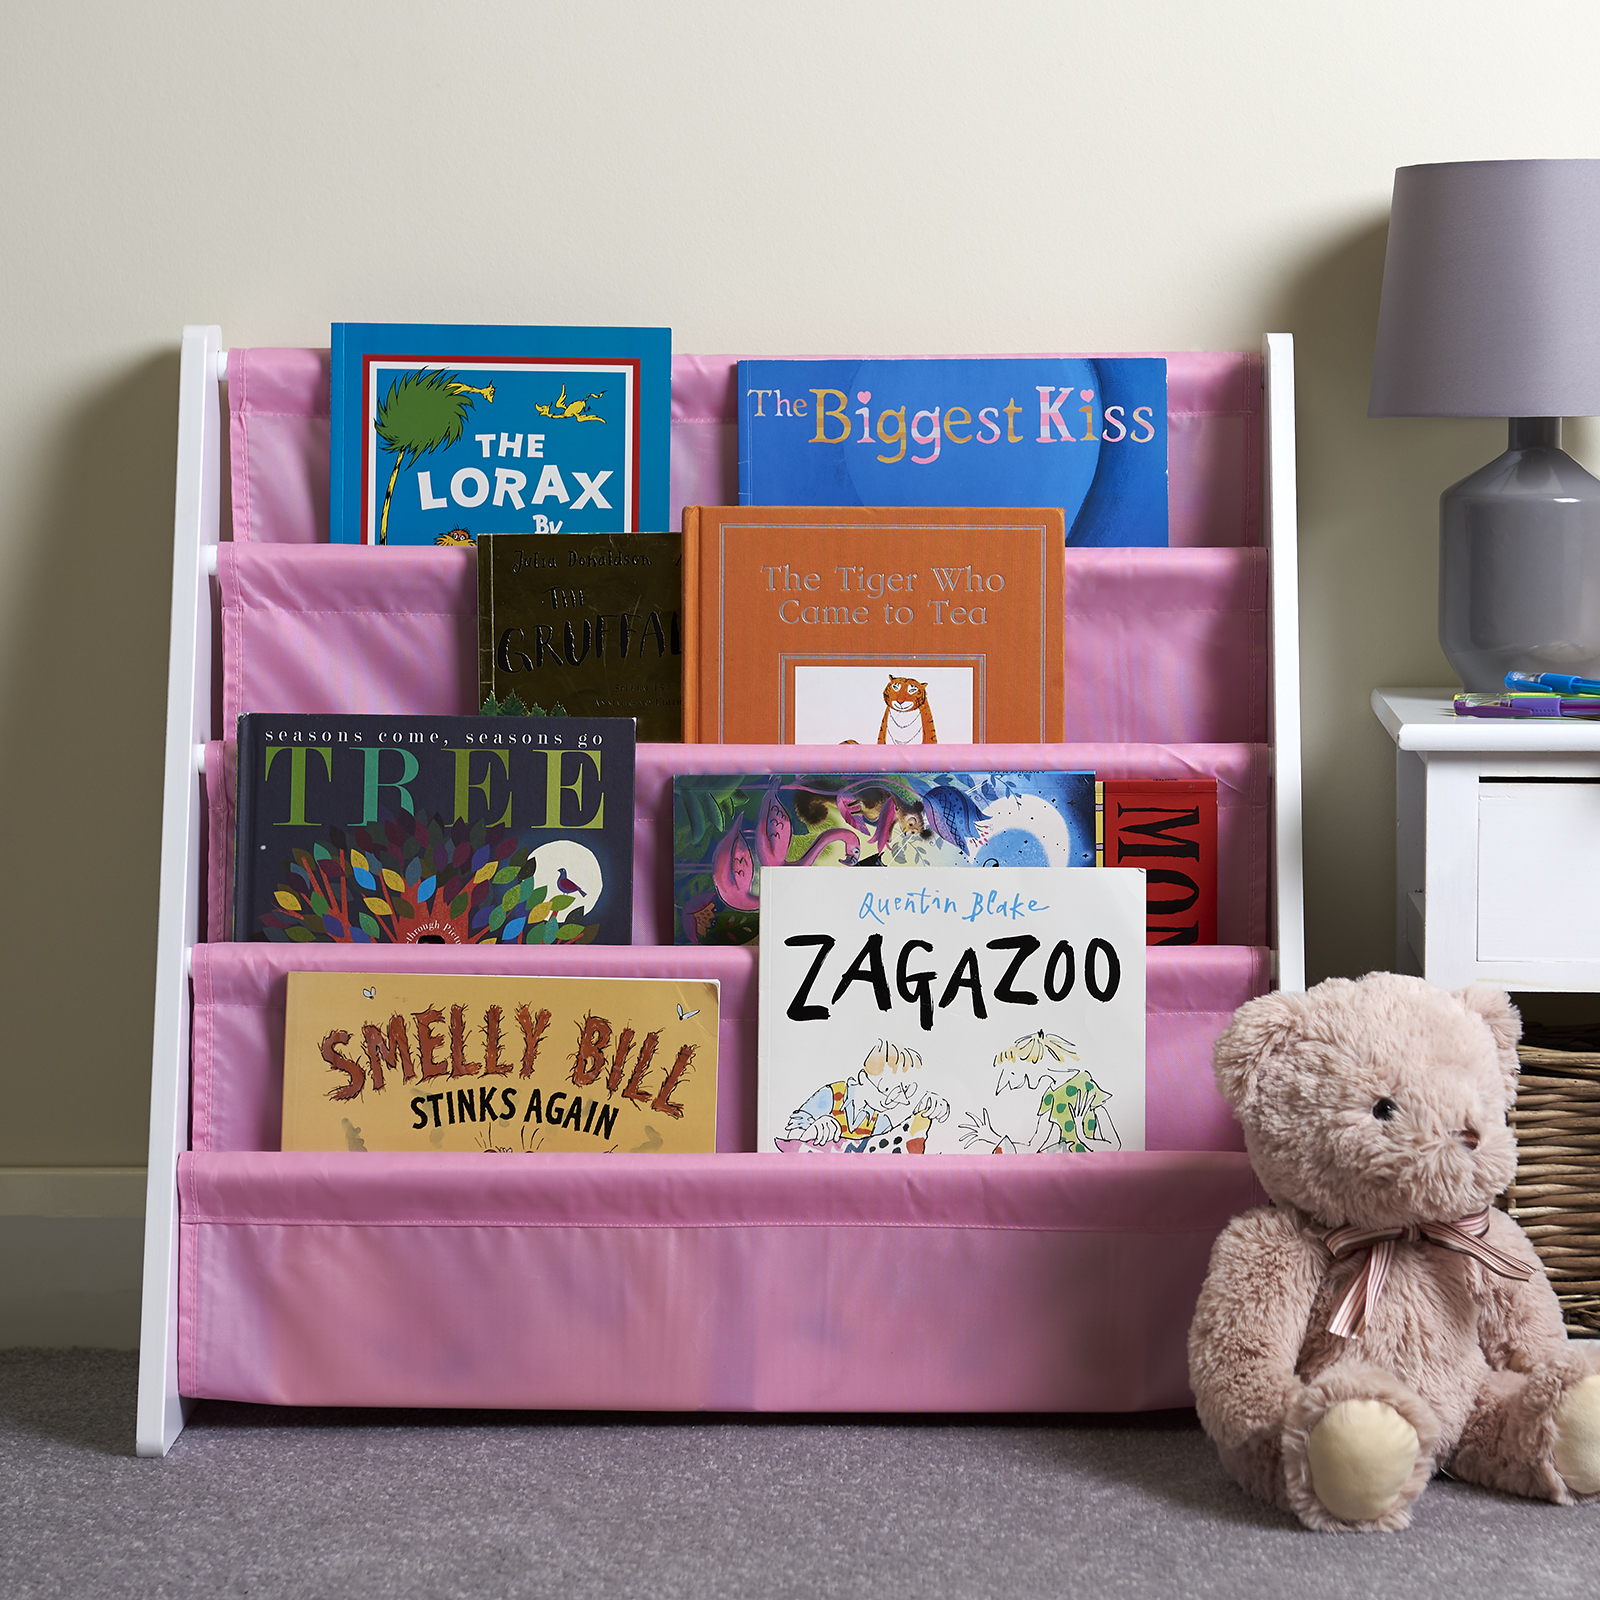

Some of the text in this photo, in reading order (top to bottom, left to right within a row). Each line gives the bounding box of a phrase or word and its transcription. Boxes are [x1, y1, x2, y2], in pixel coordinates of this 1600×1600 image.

[748, 385, 1155, 465] The Biggest Kiss
[475, 432, 545, 458] THE
[417, 464, 614, 511] LORAX
[512, 550, 557, 574] Julia
[566, 550, 652, 568] Donaldson
[543, 586, 587, 610] THE
[760, 564, 1006, 599] The Tiger Who
[778, 599, 988, 625] Came to Tea
[264, 729, 604, 750] seasons come, seasons go
[264, 746, 605, 829] TREE
[858, 887, 1050, 924] Quentin Blake
[783, 933, 1122, 1031] ZAGAZOO
[317, 1003, 701, 1120] SMELLY BILL
[411, 1086, 619, 1141] STINKS AGAIN
